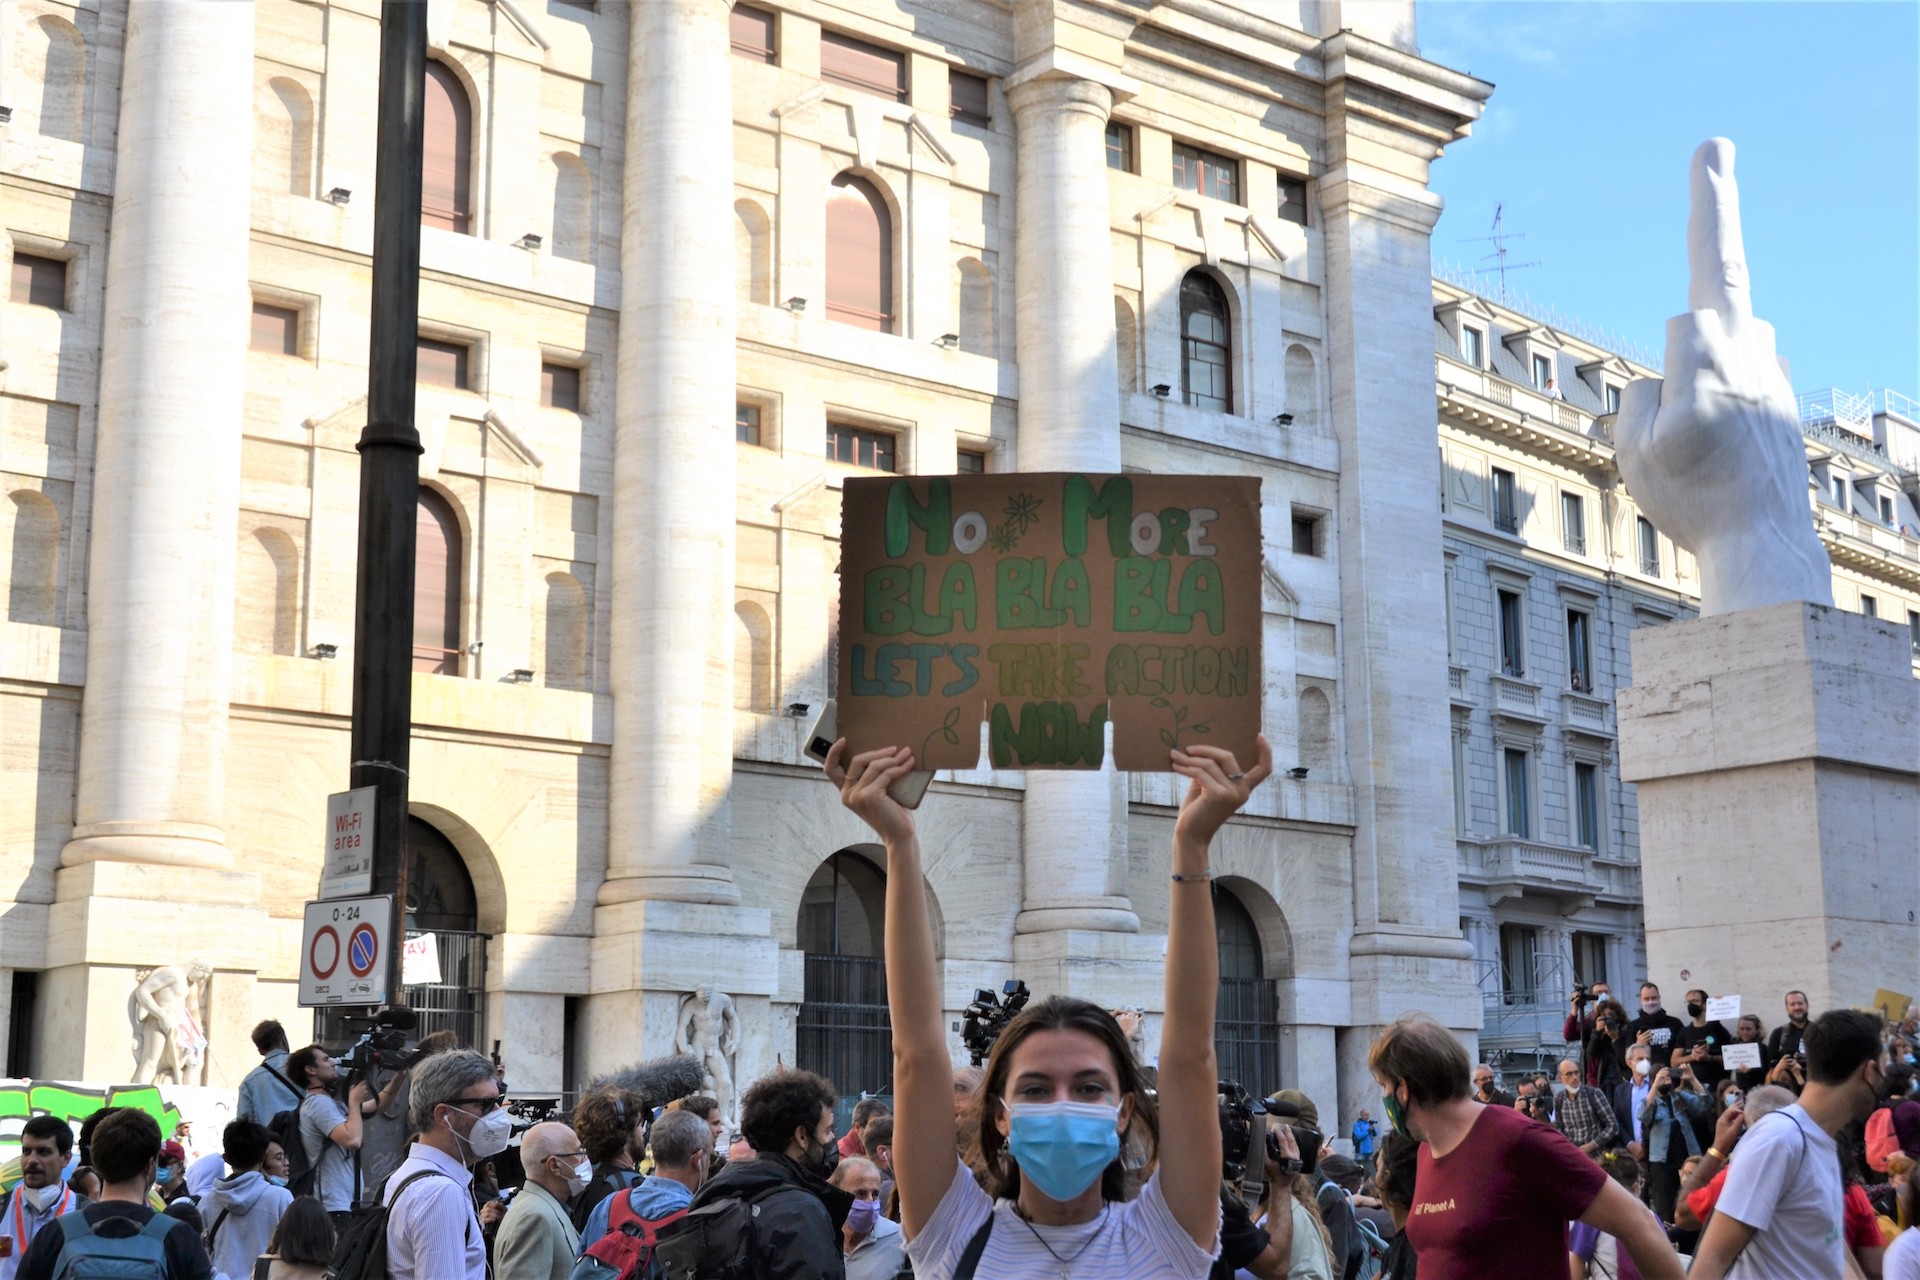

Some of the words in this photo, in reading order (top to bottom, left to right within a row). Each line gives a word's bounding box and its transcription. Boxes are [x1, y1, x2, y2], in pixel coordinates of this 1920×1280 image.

[1062, 475, 1219, 557] MORE
[864, 561, 978, 636] BLA
[996, 557, 1091, 629] BLA
[1114, 556, 1225, 635] BLA
[851, 642, 980, 697] LET'S
[988, 642, 1091, 697] TAKE
[1105, 644, 1249, 698] ACTION
[990, 701, 1108, 766] NOW
[335, 812, 362, 832] Wi-Fi
[334, 834, 361, 850] area
[347, 905, 361, 920] 24
[1424, 1200, 1447, 1214] Planet
[1448, 1198, 1455, 1209] A
